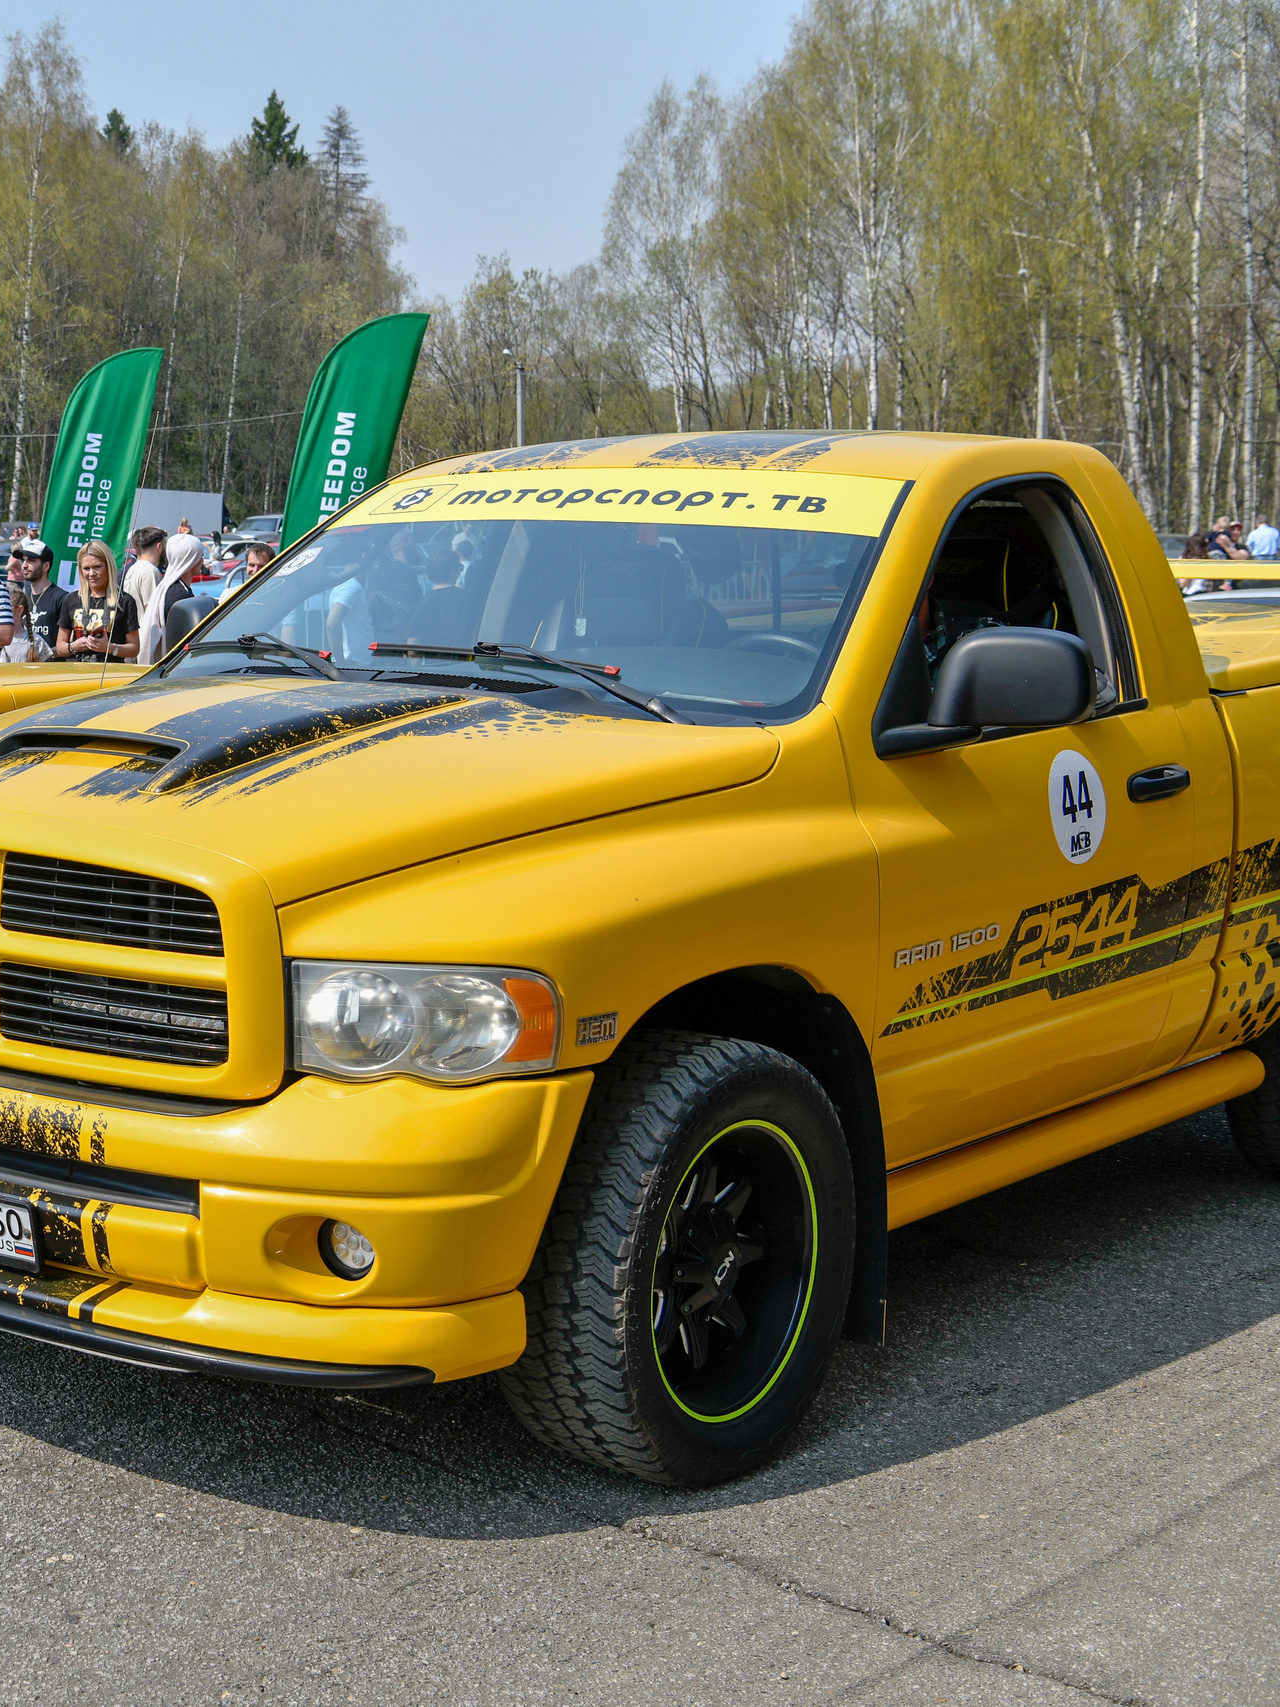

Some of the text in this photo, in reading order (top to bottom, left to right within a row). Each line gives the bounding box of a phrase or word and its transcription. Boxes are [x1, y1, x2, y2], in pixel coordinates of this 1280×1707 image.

[67, 432, 103, 548] FREEDOM
[318, 412, 357, 526] EEDOM
[86, 479, 112, 542] inance
[1062, 770, 1094, 823] 44
[894, 923, 1001, 969] RAM 1500
[1009, 884, 1141, 980] 2544
[578, 1018, 618, 1041] HEMI
[714, 1250, 735, 1286] ION
